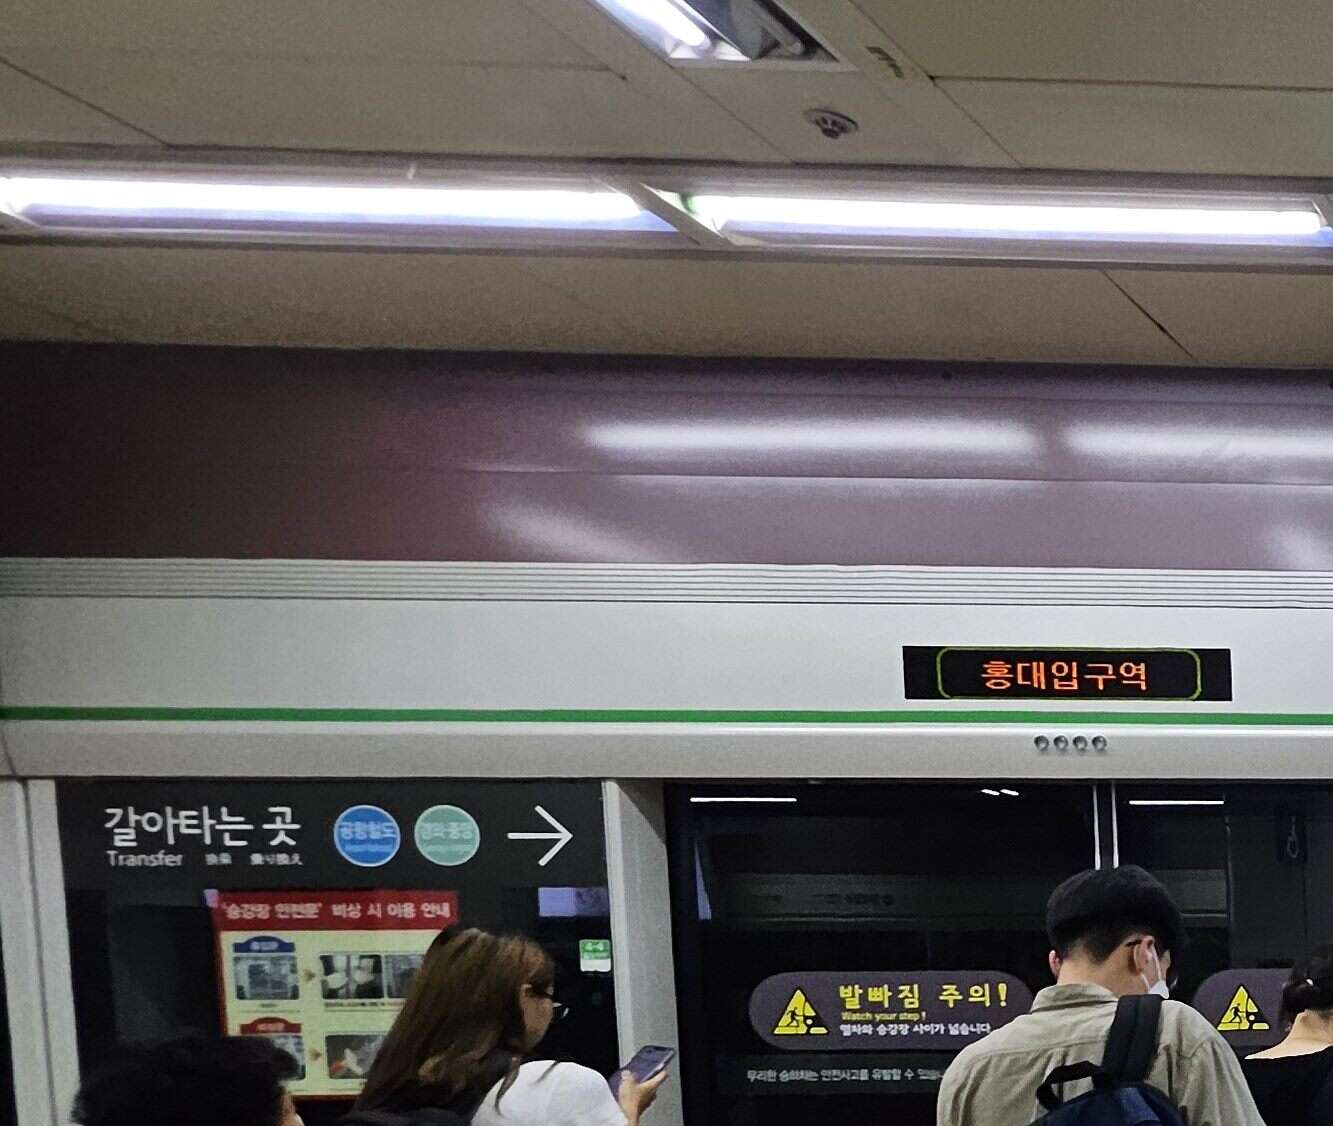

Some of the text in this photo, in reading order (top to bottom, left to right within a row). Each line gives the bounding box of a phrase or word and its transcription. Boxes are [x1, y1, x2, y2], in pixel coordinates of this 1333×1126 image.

[981, 661, 1147, 690] 홍대입구역
[104, 805, 301, 846] 갈아타는 곳
[106, 850, 183, 867] Transfer
[839, 983, 1009, 1009] 발빠짐 주의!
[913, 1023, 945, 1035] 사이가
